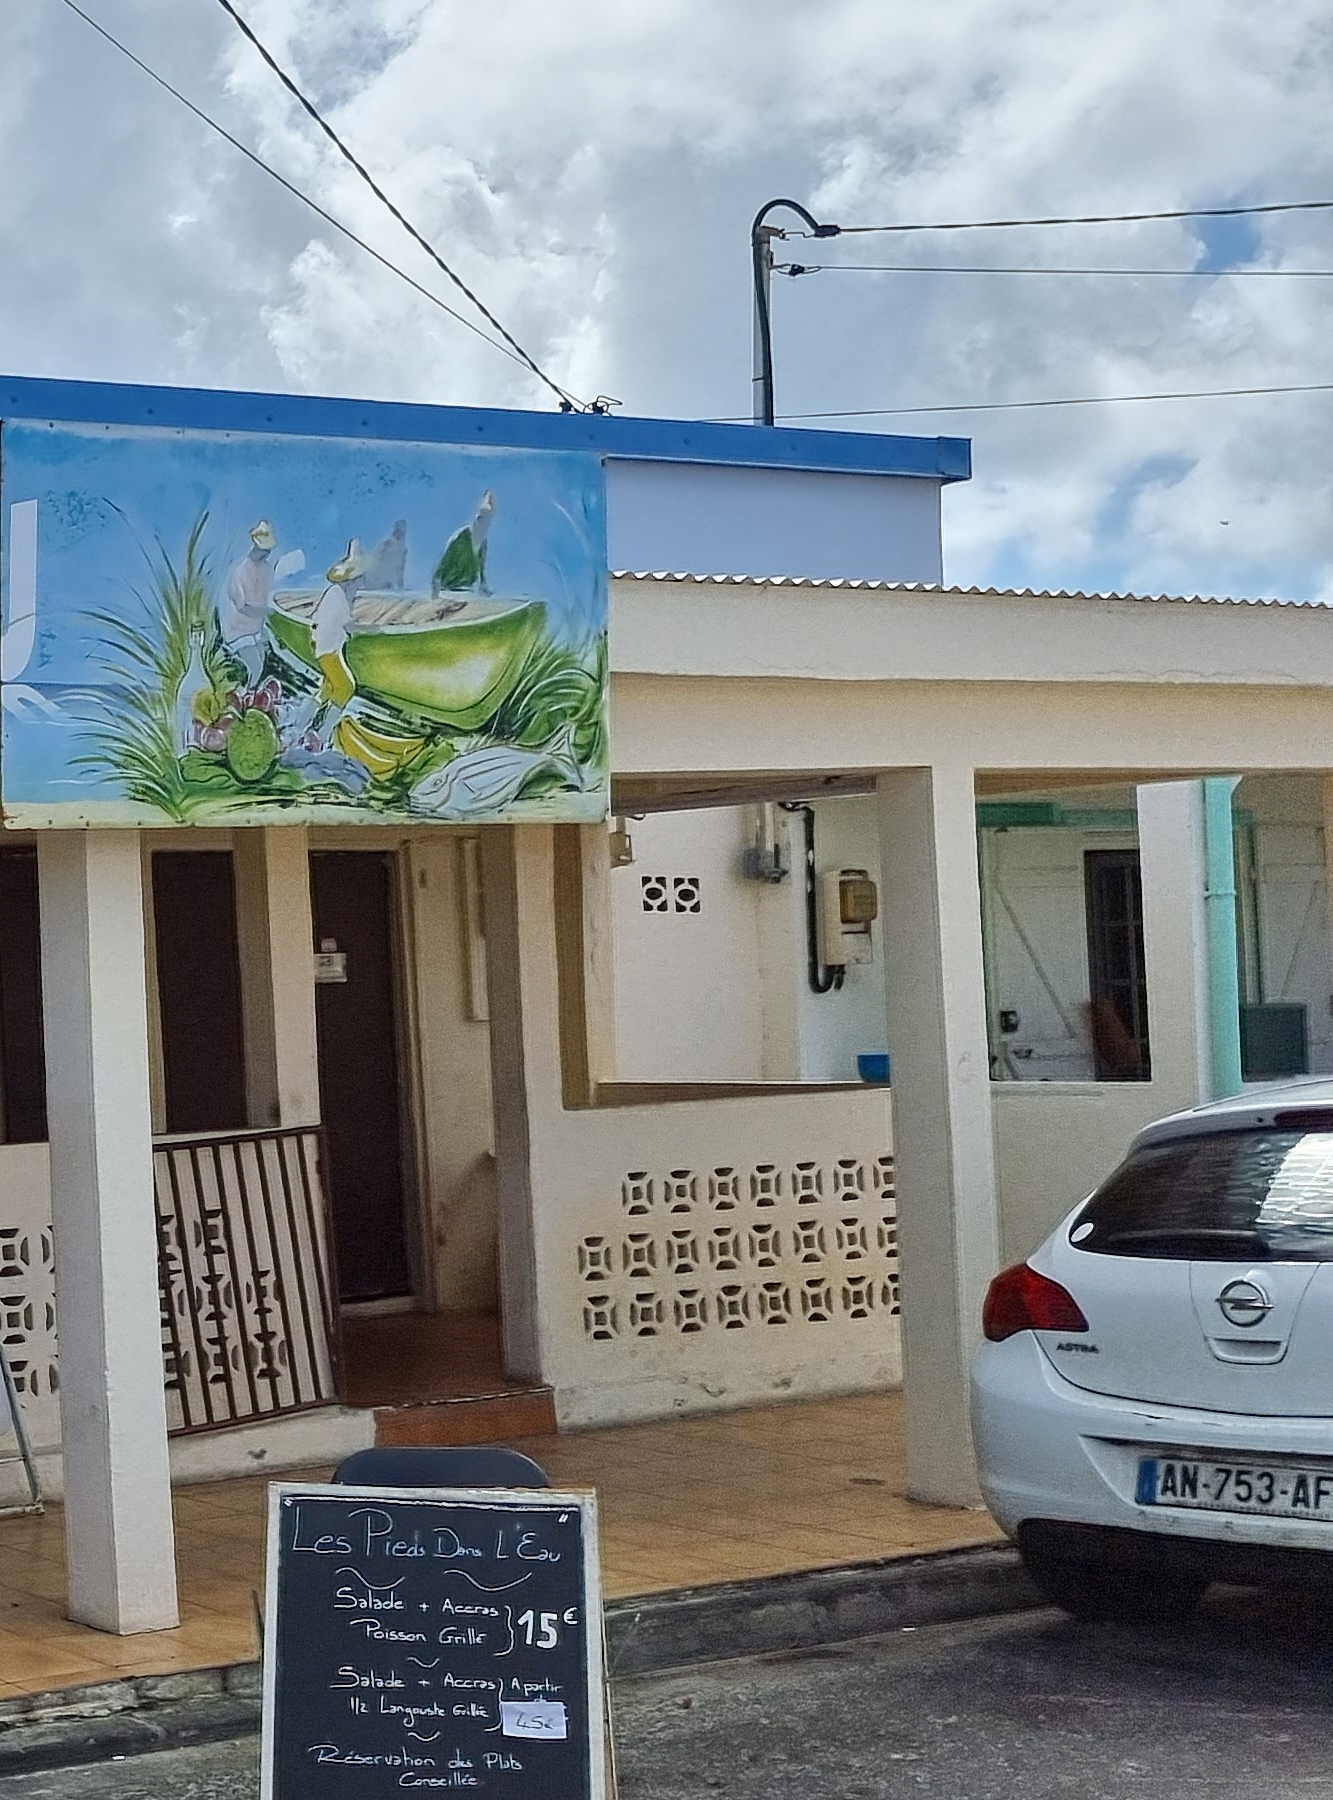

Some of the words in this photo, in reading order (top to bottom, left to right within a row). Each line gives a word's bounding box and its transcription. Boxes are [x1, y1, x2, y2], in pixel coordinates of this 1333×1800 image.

[1160, 1463, 1333, 1510] AN-753-AF
[348, 1507, 426, 1559] Pieds
[433, 1527, 483, 1559] Dans
[333, 1586, 406, 1611] Salade
[441, 1598, 500, 1618] Accras
[349, 1618, 427, 1643] Poisson
[329, 1666, 406, 1689] Salade
[443, 1671, 496, 1690] Accras
[379, 1694, 447, 1728] Langouste
[484, 1751, 524, 1771] Plats
